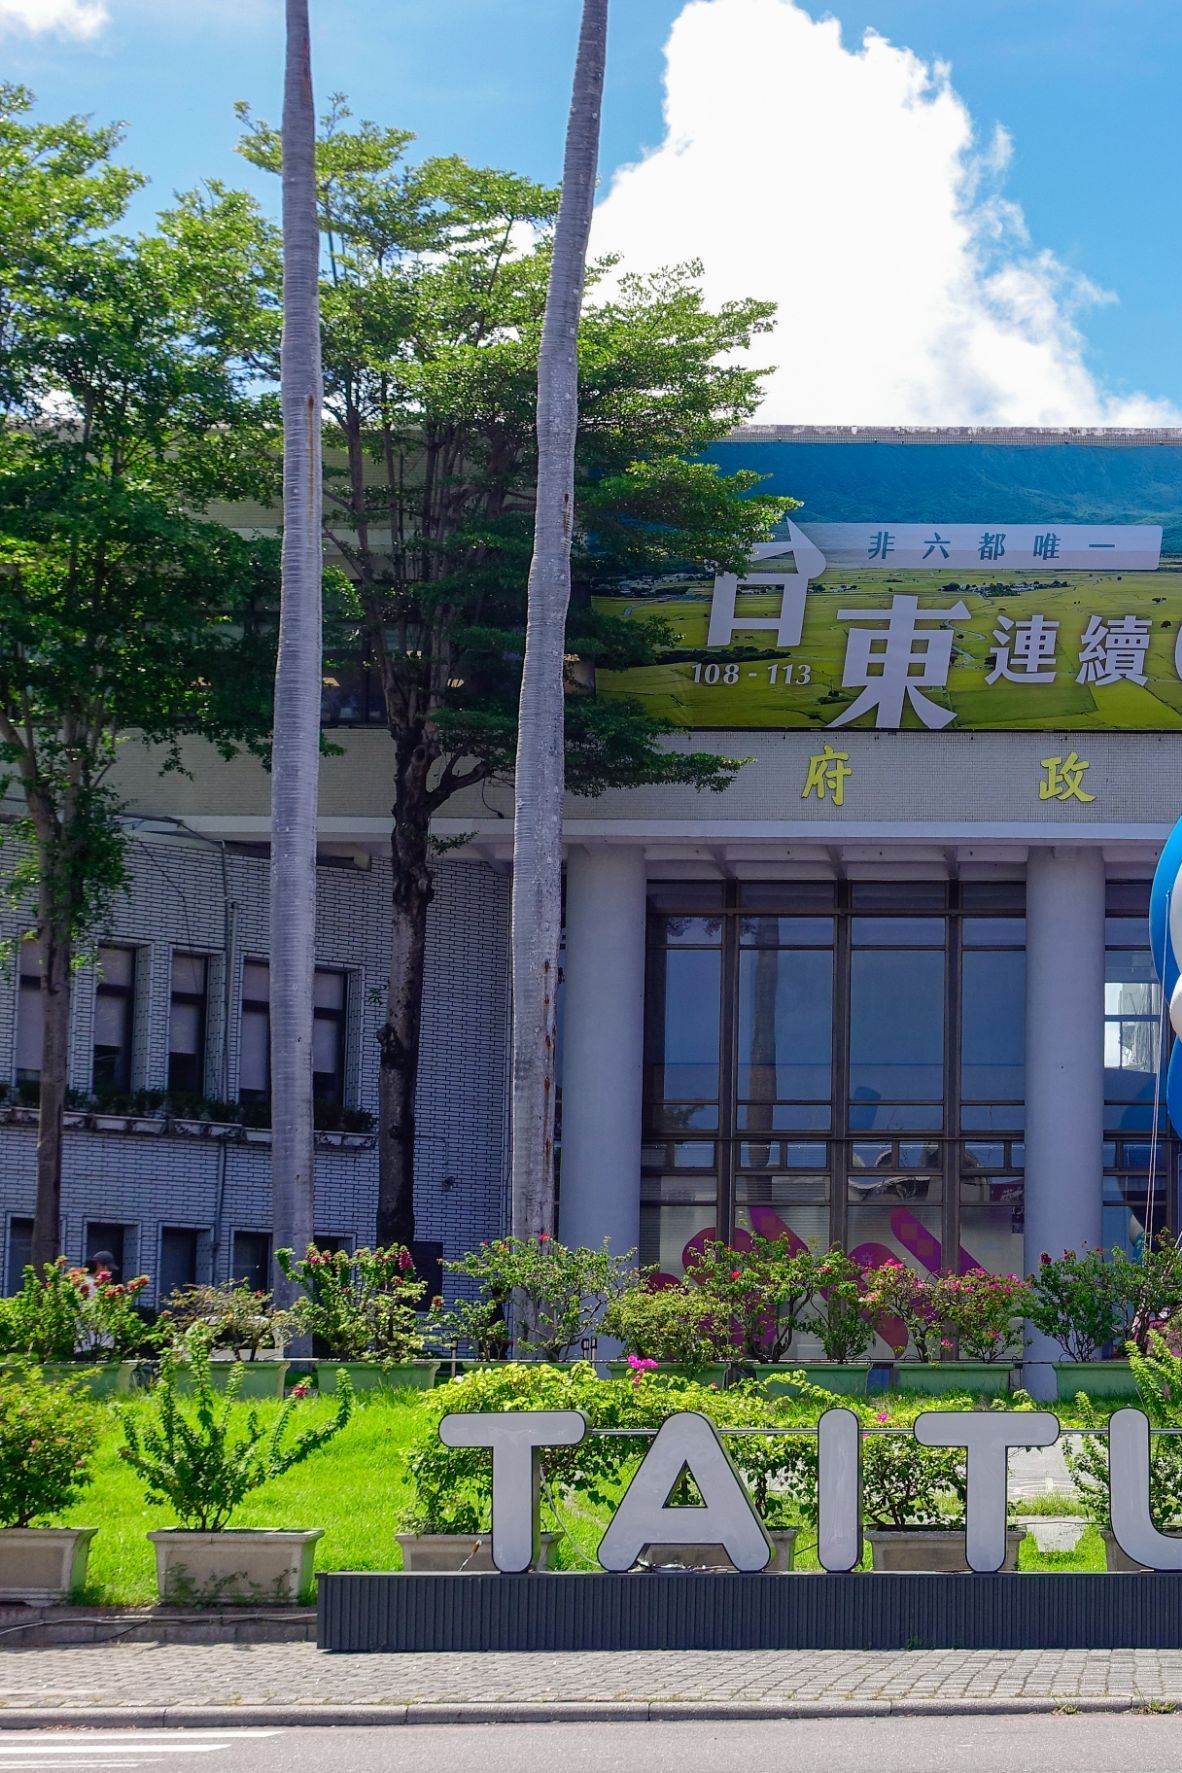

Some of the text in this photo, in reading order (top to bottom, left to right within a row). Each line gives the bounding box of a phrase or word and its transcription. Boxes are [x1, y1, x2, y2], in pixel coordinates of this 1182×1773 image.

[867, 531, 1116, 561] 非六都唯一
[691, 662, 740, 685] 108
[767, 663, 812, 686] 113
